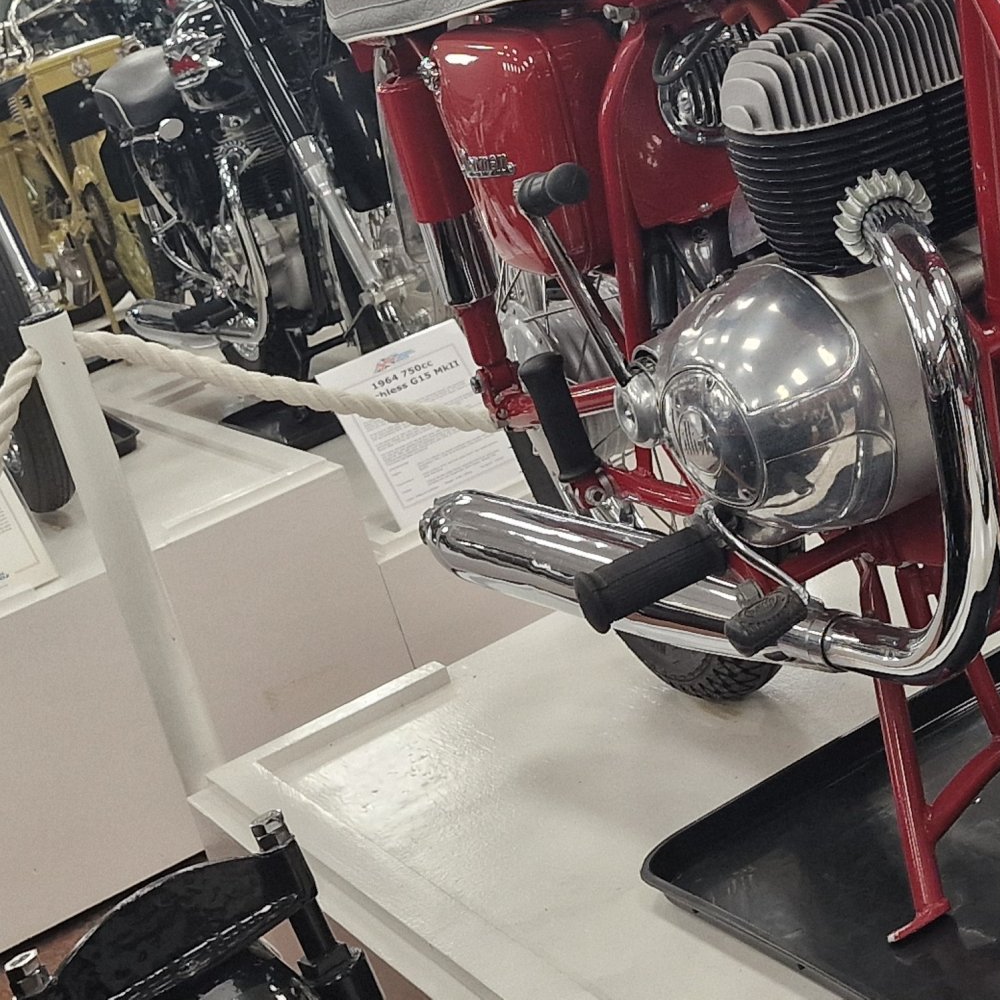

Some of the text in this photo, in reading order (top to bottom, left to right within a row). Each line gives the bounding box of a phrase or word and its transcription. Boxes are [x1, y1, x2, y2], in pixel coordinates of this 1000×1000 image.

[372, 360, 434, 390] 1964 750cc
[410, 371, 432, 385] G15
[433, 360, 460, 376] MkII
